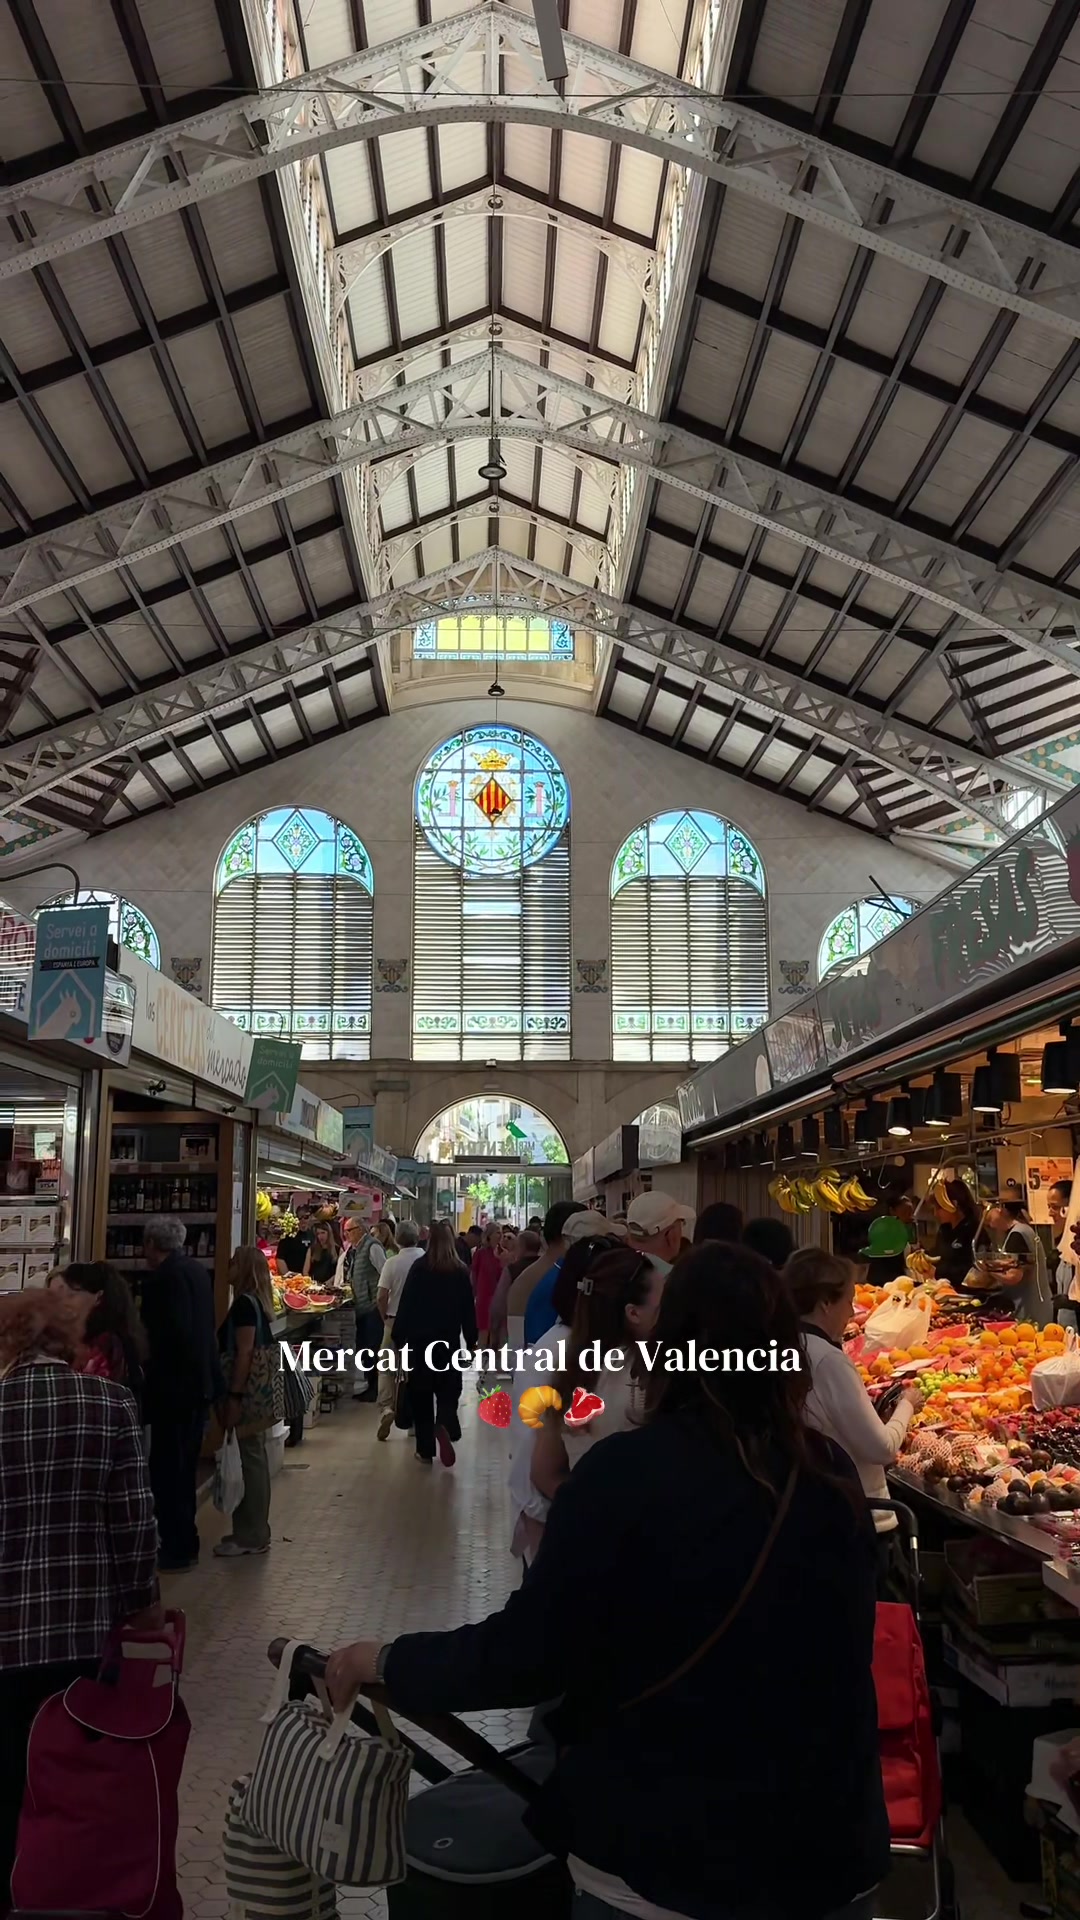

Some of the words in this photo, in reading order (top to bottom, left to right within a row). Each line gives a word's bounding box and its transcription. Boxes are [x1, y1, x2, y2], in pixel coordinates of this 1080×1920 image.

[46, 923, 86, 939] Servei
[90, 926, 97, 936] a
[44, 940, 96, 958] domicili
[1028, 1167, 1041, 1190] 5
